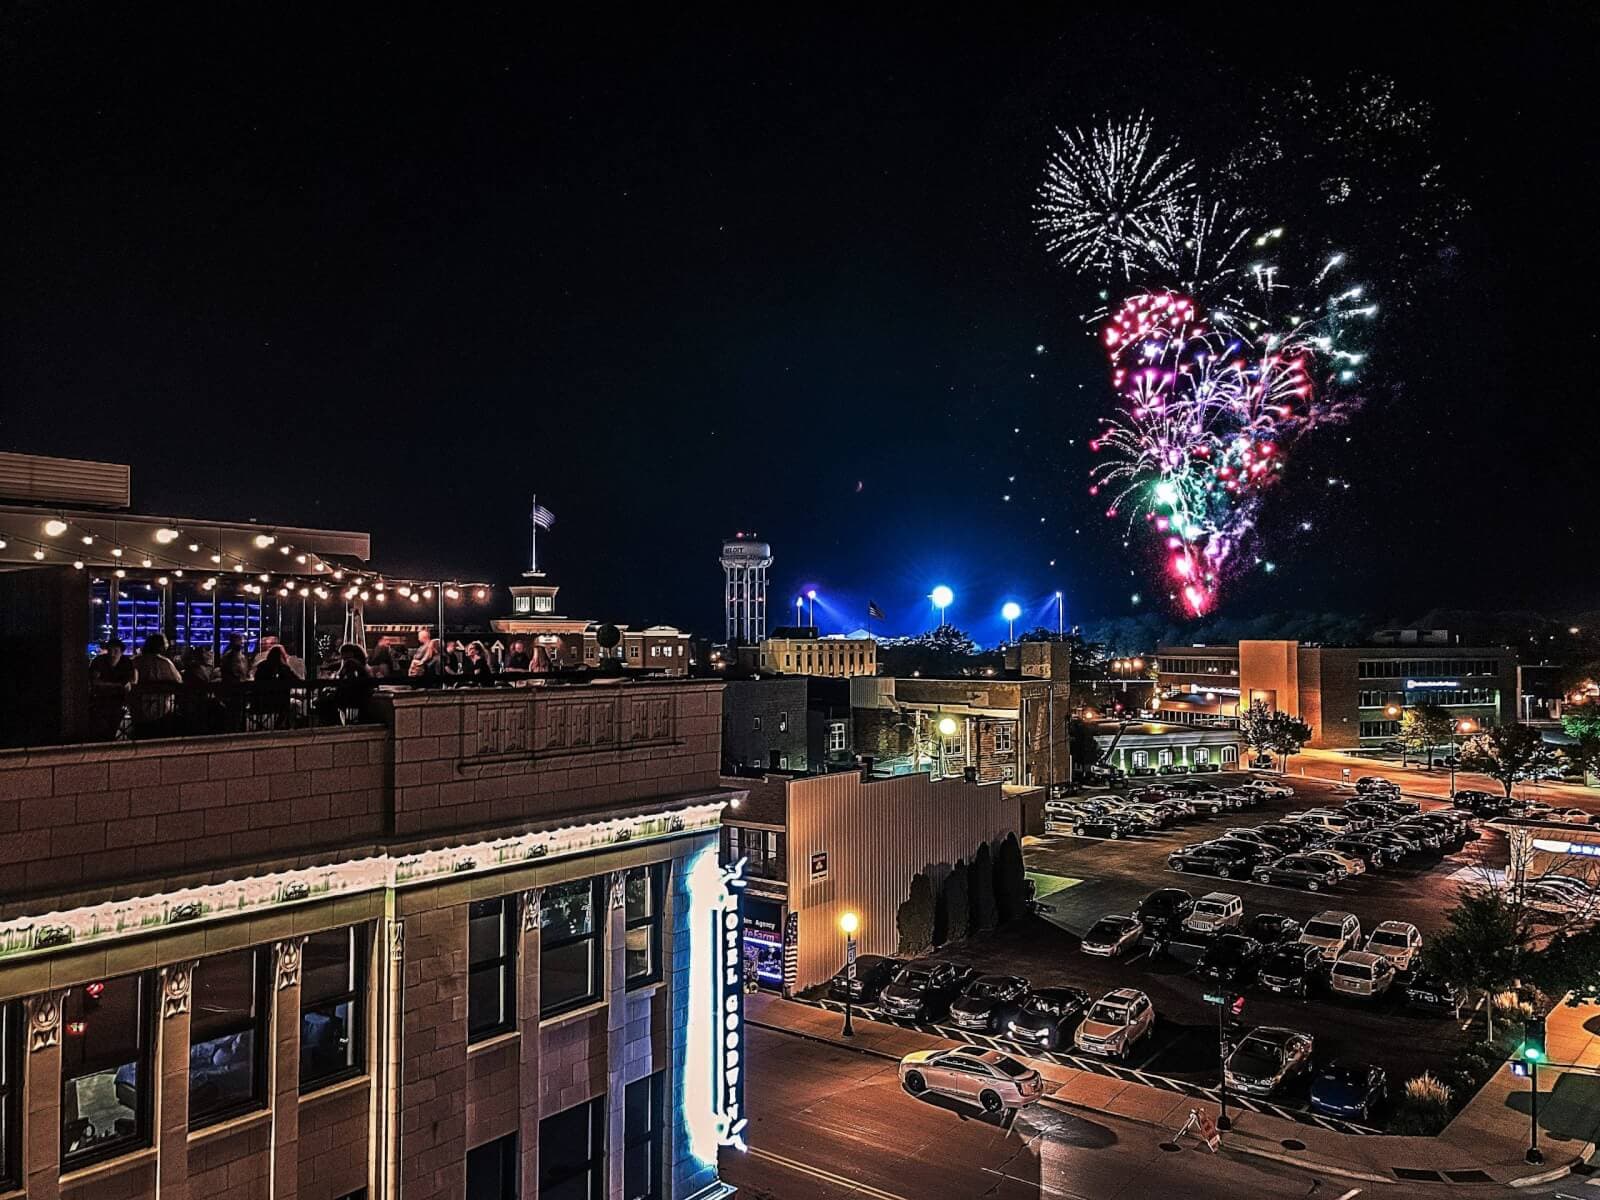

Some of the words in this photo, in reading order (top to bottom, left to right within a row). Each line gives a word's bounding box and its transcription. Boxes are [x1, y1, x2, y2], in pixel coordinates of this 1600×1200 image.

[725, 894, 739, 985] HOTEL
[755, 919, 776, 930] Agency
[725, 995, 739, 1120] GOODWIN
